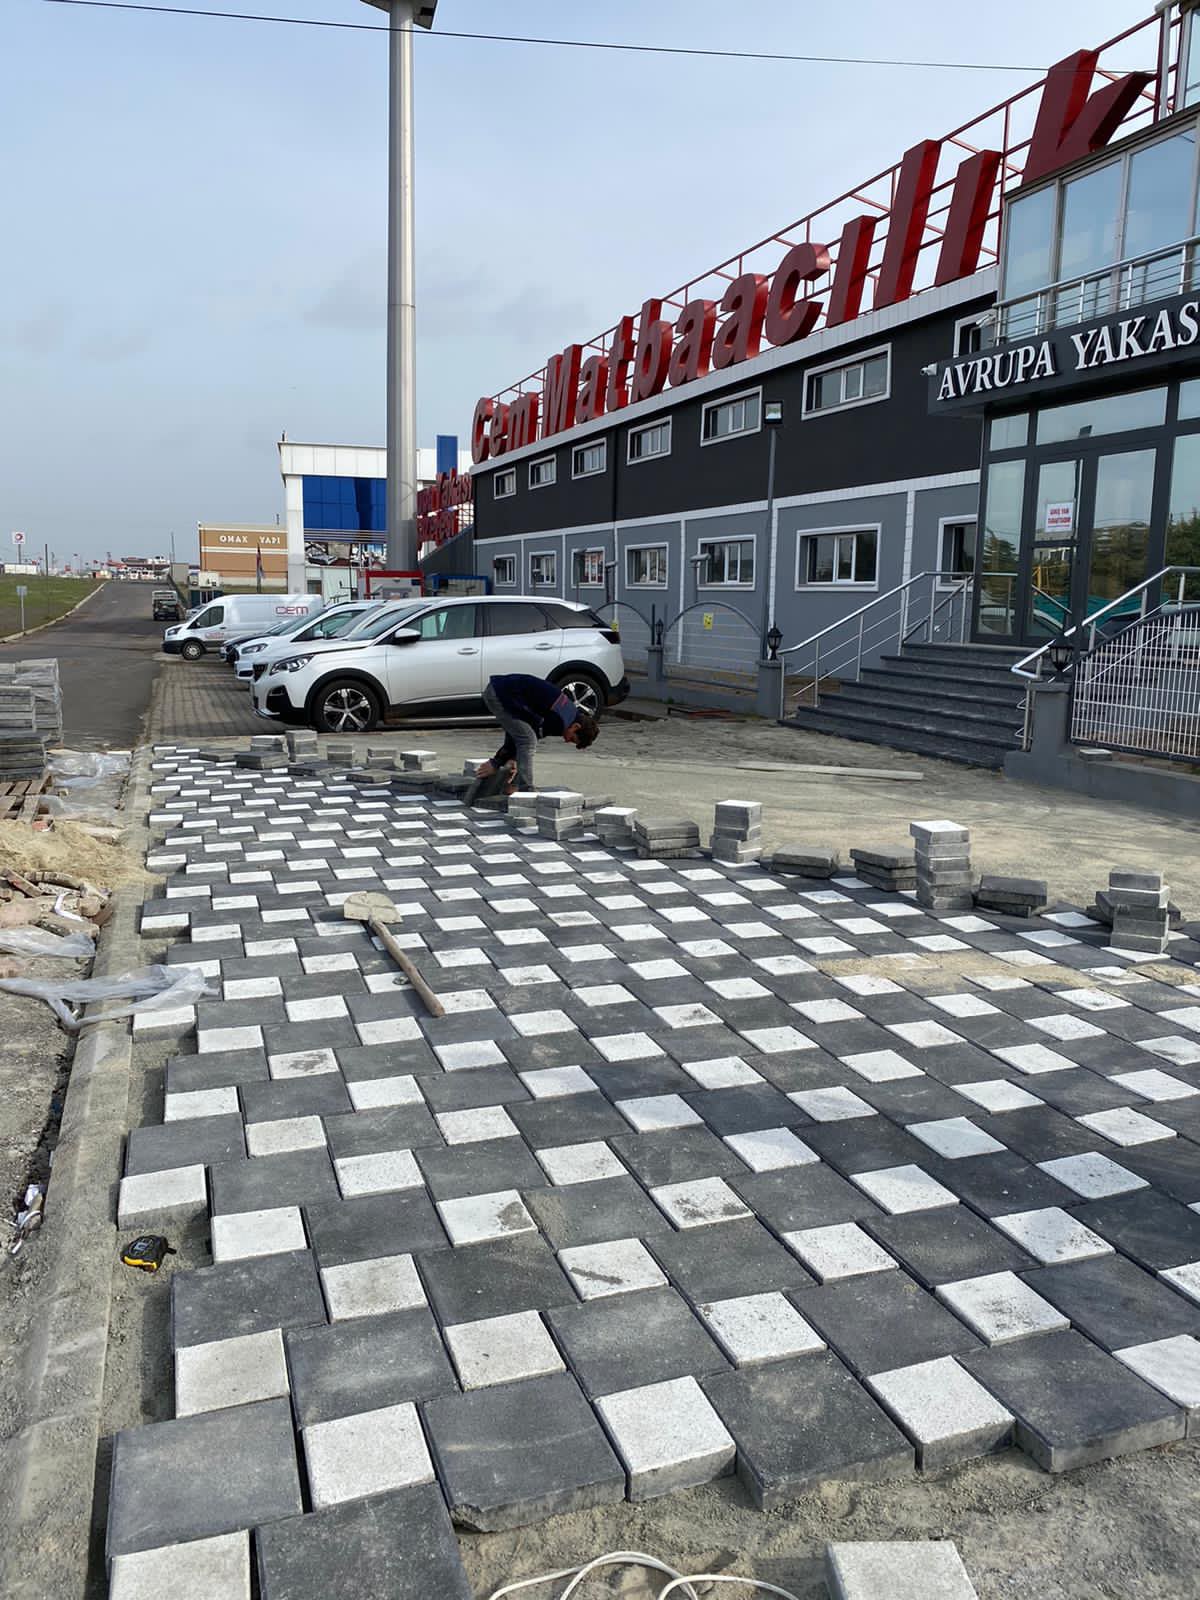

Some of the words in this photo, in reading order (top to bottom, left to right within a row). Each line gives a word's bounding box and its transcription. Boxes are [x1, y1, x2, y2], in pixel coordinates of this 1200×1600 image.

[937, 340, 1055, 401] AVRUPA
[1070, 302, 1199, 370] YAKAS
[471, 391, 540, 464] Cem
